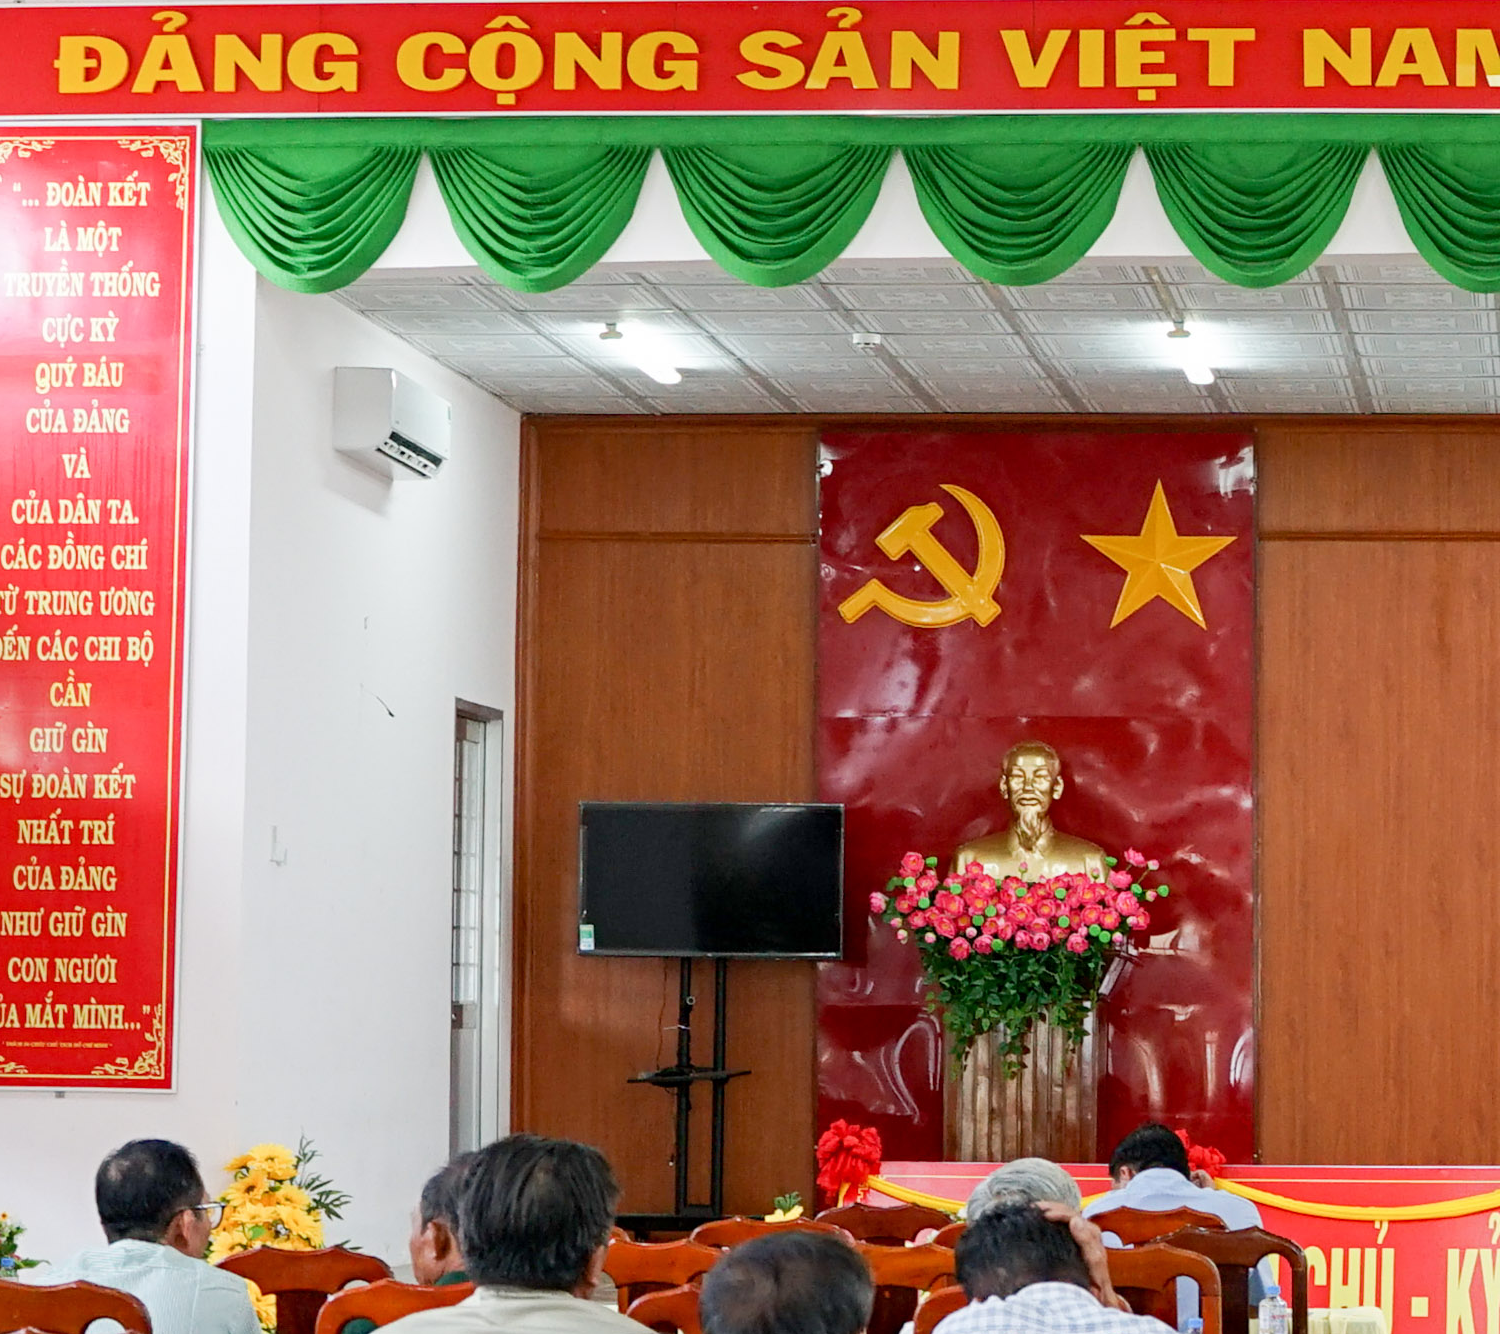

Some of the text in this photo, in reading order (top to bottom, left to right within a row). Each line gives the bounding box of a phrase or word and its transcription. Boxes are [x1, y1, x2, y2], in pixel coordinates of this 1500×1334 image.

[54, 11, 358, 93] ĐẢNG
[397, 16, 698, 104] CỘNG
[736, 7, 959, 90] SẢN
[1000, 13, 1255, 100] VIỆT
[45, 175, 102, 207] ĐOÀN
[107, 171, 150, 206] KẾT
[43, 220, 122, 257] LÀ MỘT
[4, 258, 160, 297] TRUYỀN THỐNG
[43, 310, 119, 347] CỰC KỲ
[36, 356, 124, 394] QUÝ BÁU
[26, 399, 130, 433] CỦA ĐẢNG
[62, 447, 91, 478] VÀ
[12, 490, 139, 524] CỦA DÂN TA.
[1, 531, 148, 570] CÁC ĐỒNG CHÍ
[24, 591, 93, 615] TRUNG
[99, 587, 155, 616] ƯƠNG
